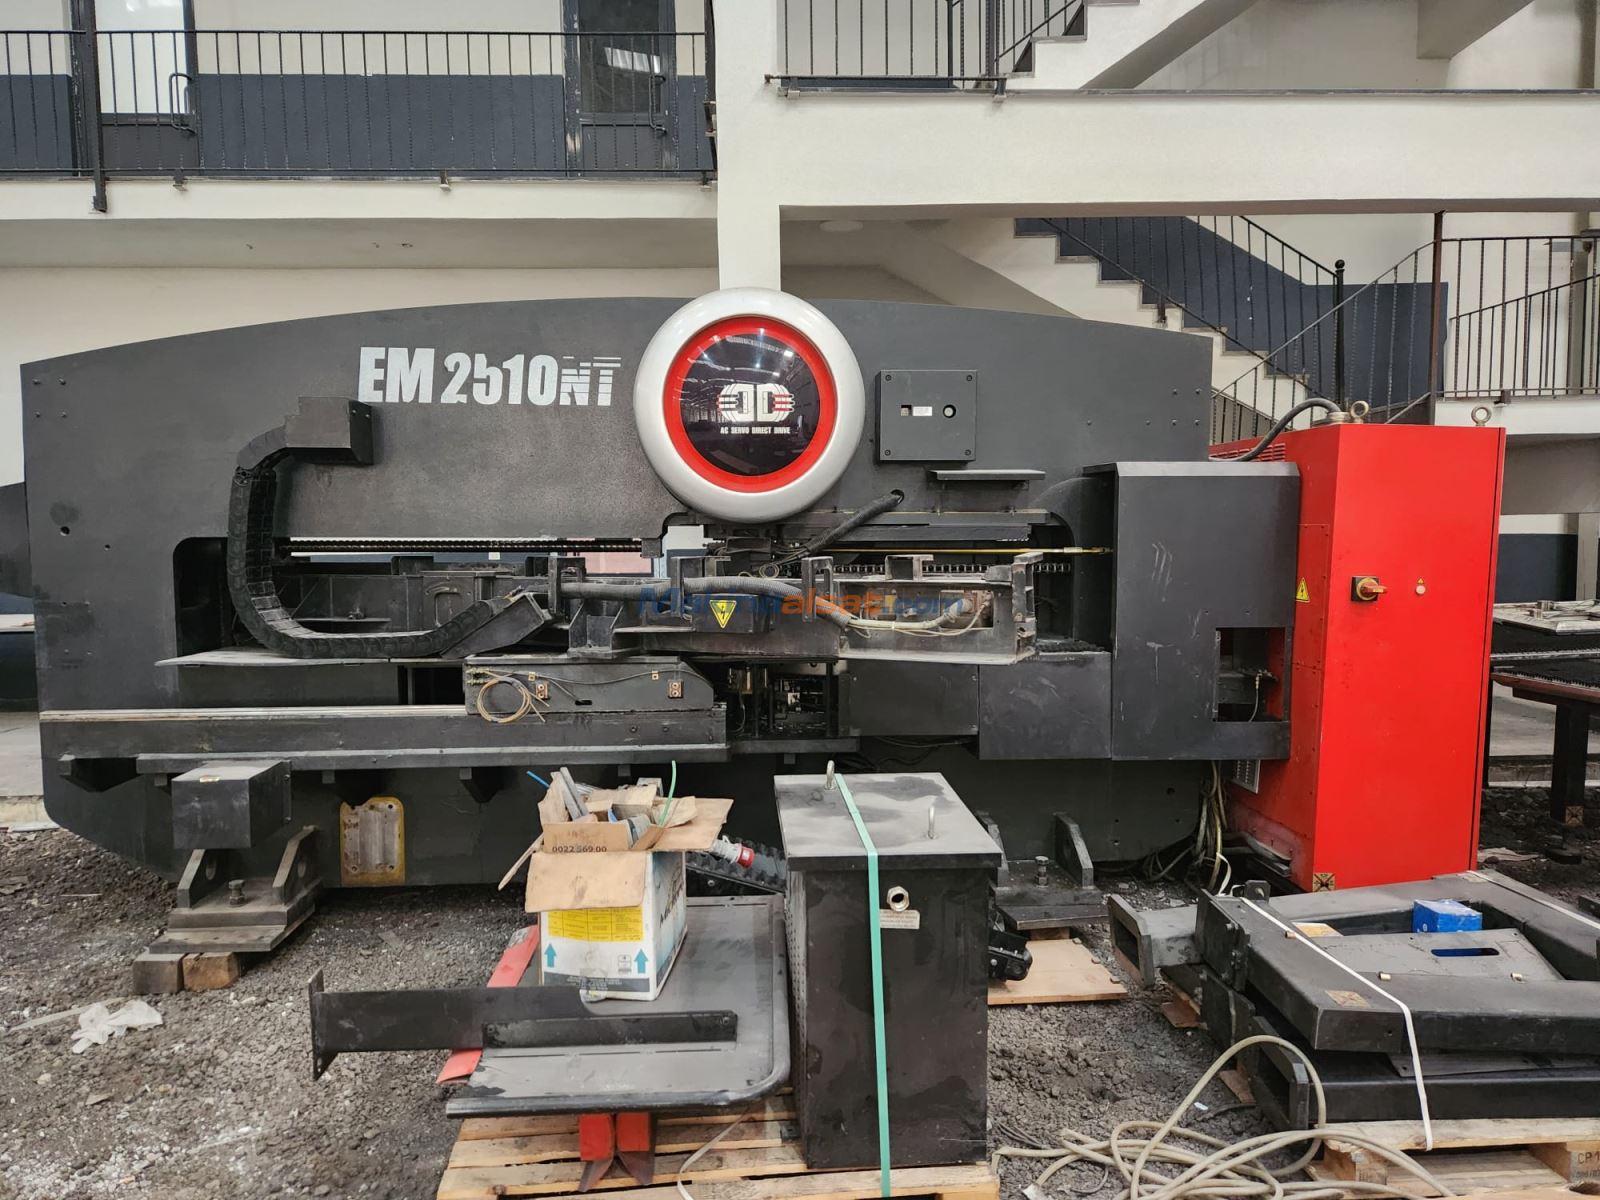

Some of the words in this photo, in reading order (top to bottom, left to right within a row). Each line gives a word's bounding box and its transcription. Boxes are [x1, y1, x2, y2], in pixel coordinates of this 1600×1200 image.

[358, 347, 435, 403] EM
[720, 426, 729, 435] AC
[731, 426, 750, 435] SERVO
[751, 426, 771, 435] DIRECT
[774, 426, 791, 435] DRIVE
